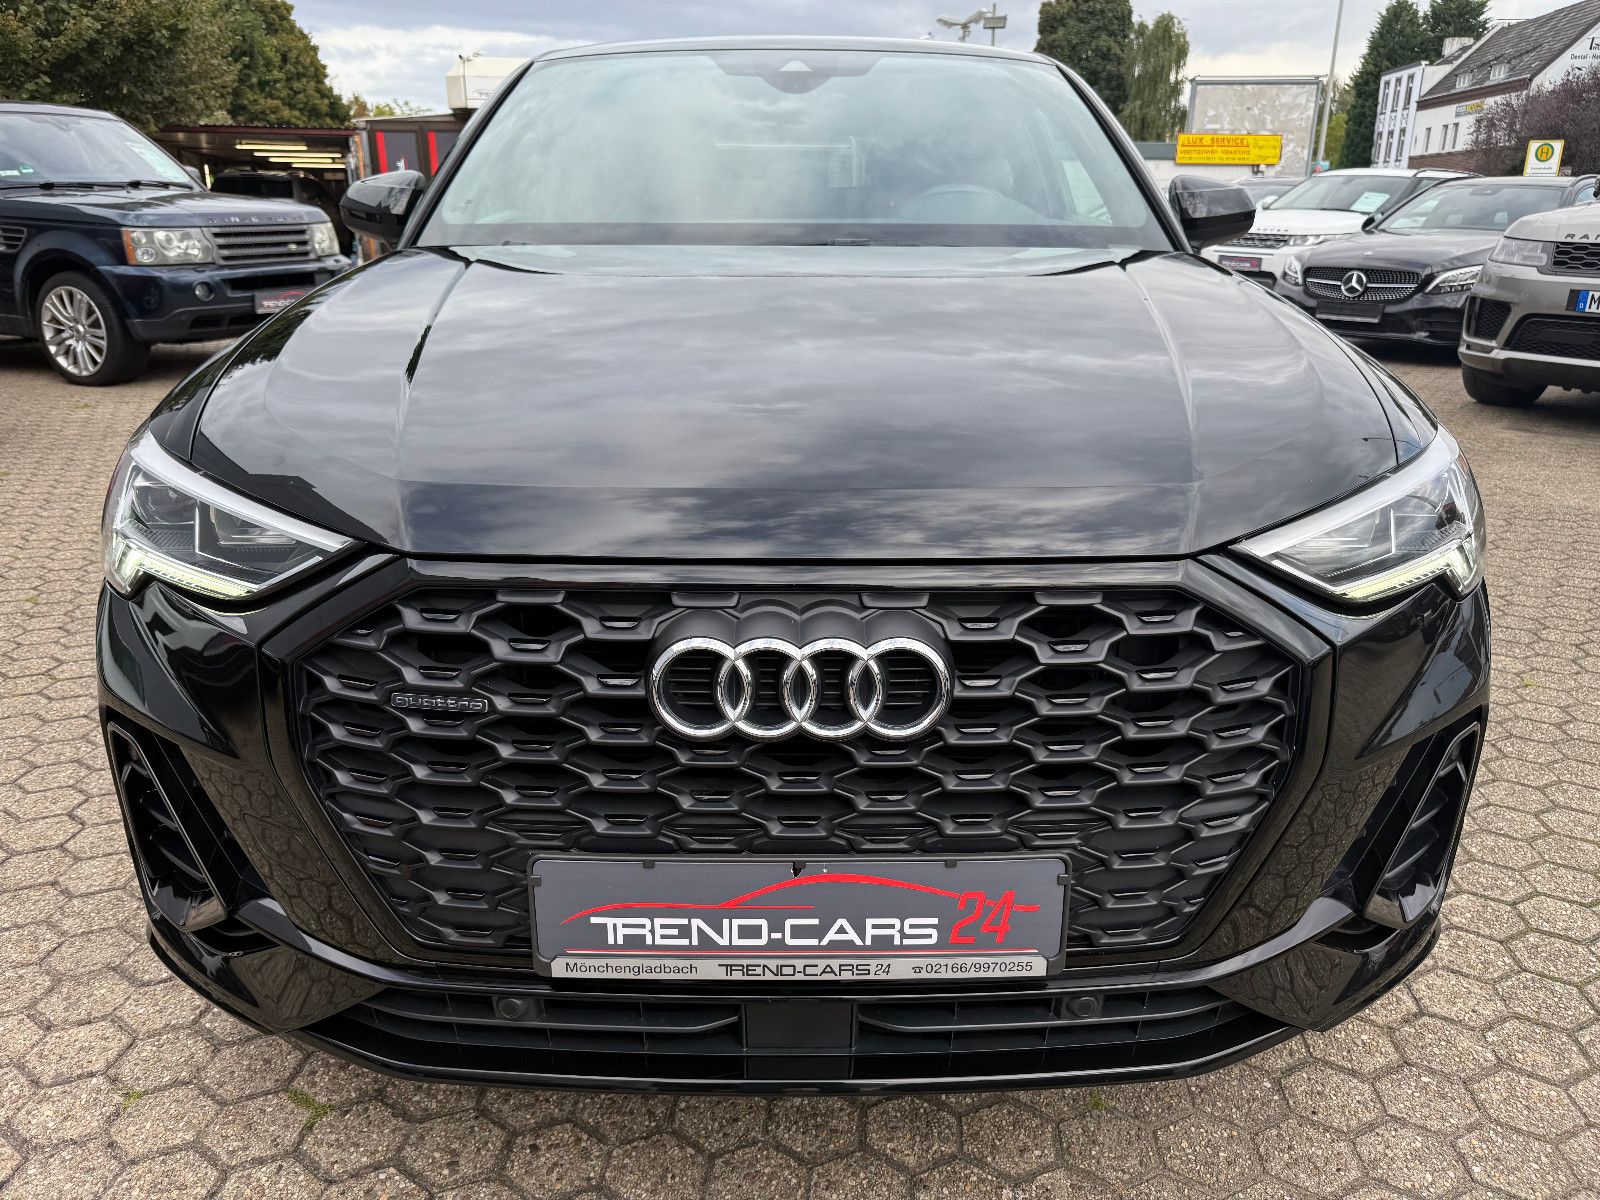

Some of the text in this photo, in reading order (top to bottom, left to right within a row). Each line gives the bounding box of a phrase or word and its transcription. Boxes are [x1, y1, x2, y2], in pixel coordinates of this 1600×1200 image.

[1187, 137, 1204, 146] LUX
[1211, 137, 1247, 147] SERVICE
[391, 694, 486, 711] quattro
[589, 890, 1016, 947] TREND-CARS 24
[565, 961, 1034, 977] Mönchengladbach TREND-CARS 24 02166/9970255
